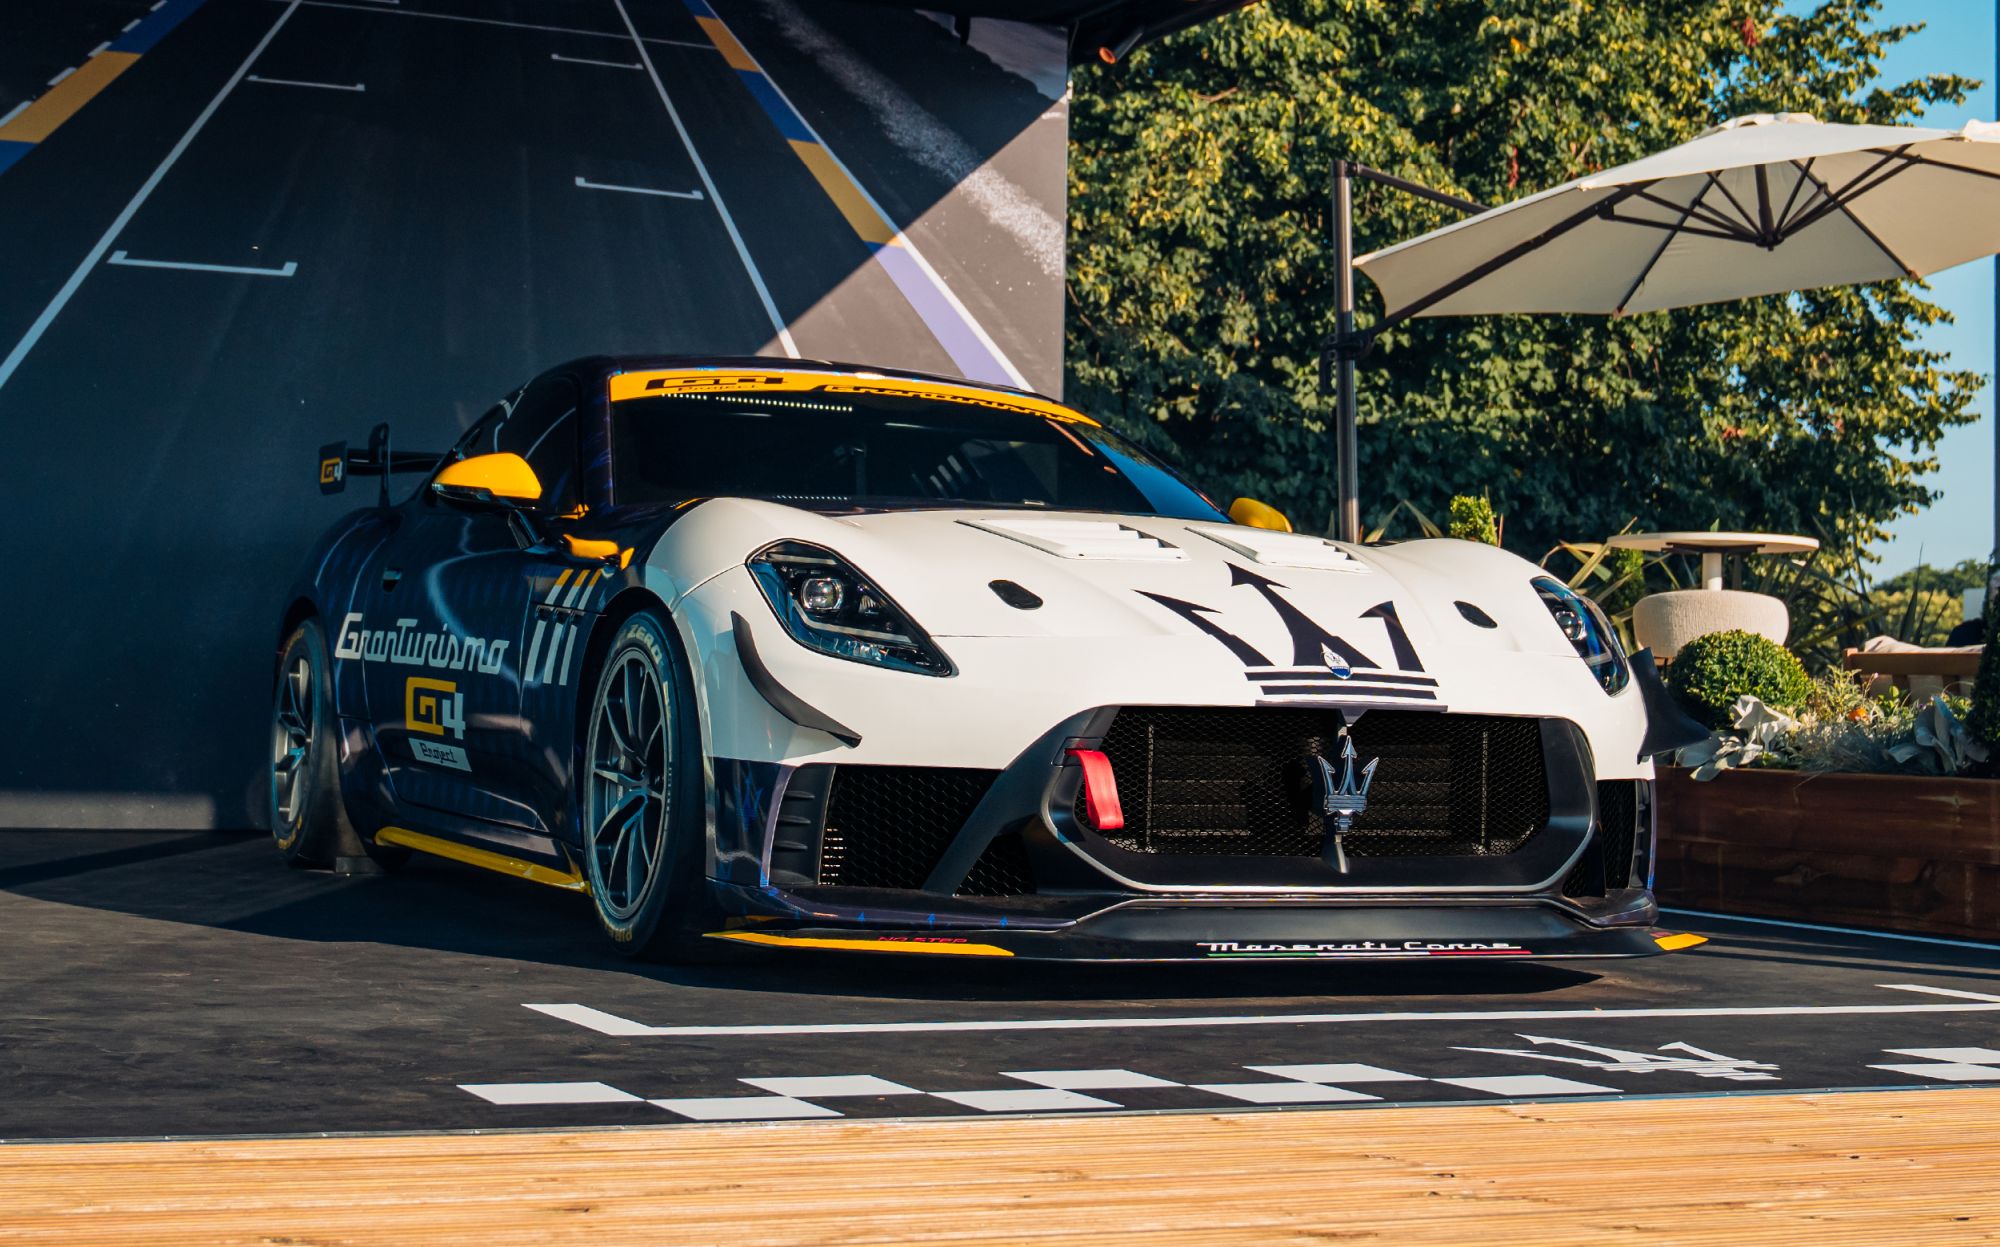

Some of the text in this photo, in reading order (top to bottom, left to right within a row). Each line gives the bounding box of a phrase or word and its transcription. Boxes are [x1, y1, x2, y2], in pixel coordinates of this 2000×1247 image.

[320, 457, 343, 483] G4
[335, 612, 510, 675] GranTurismo
[626, 624, 663, 664] ZERO
[405, 676, 466, 740] G4
[419, 742, 458, 764] Project
[1196, 941, 1521, 950] Maserati Corse
